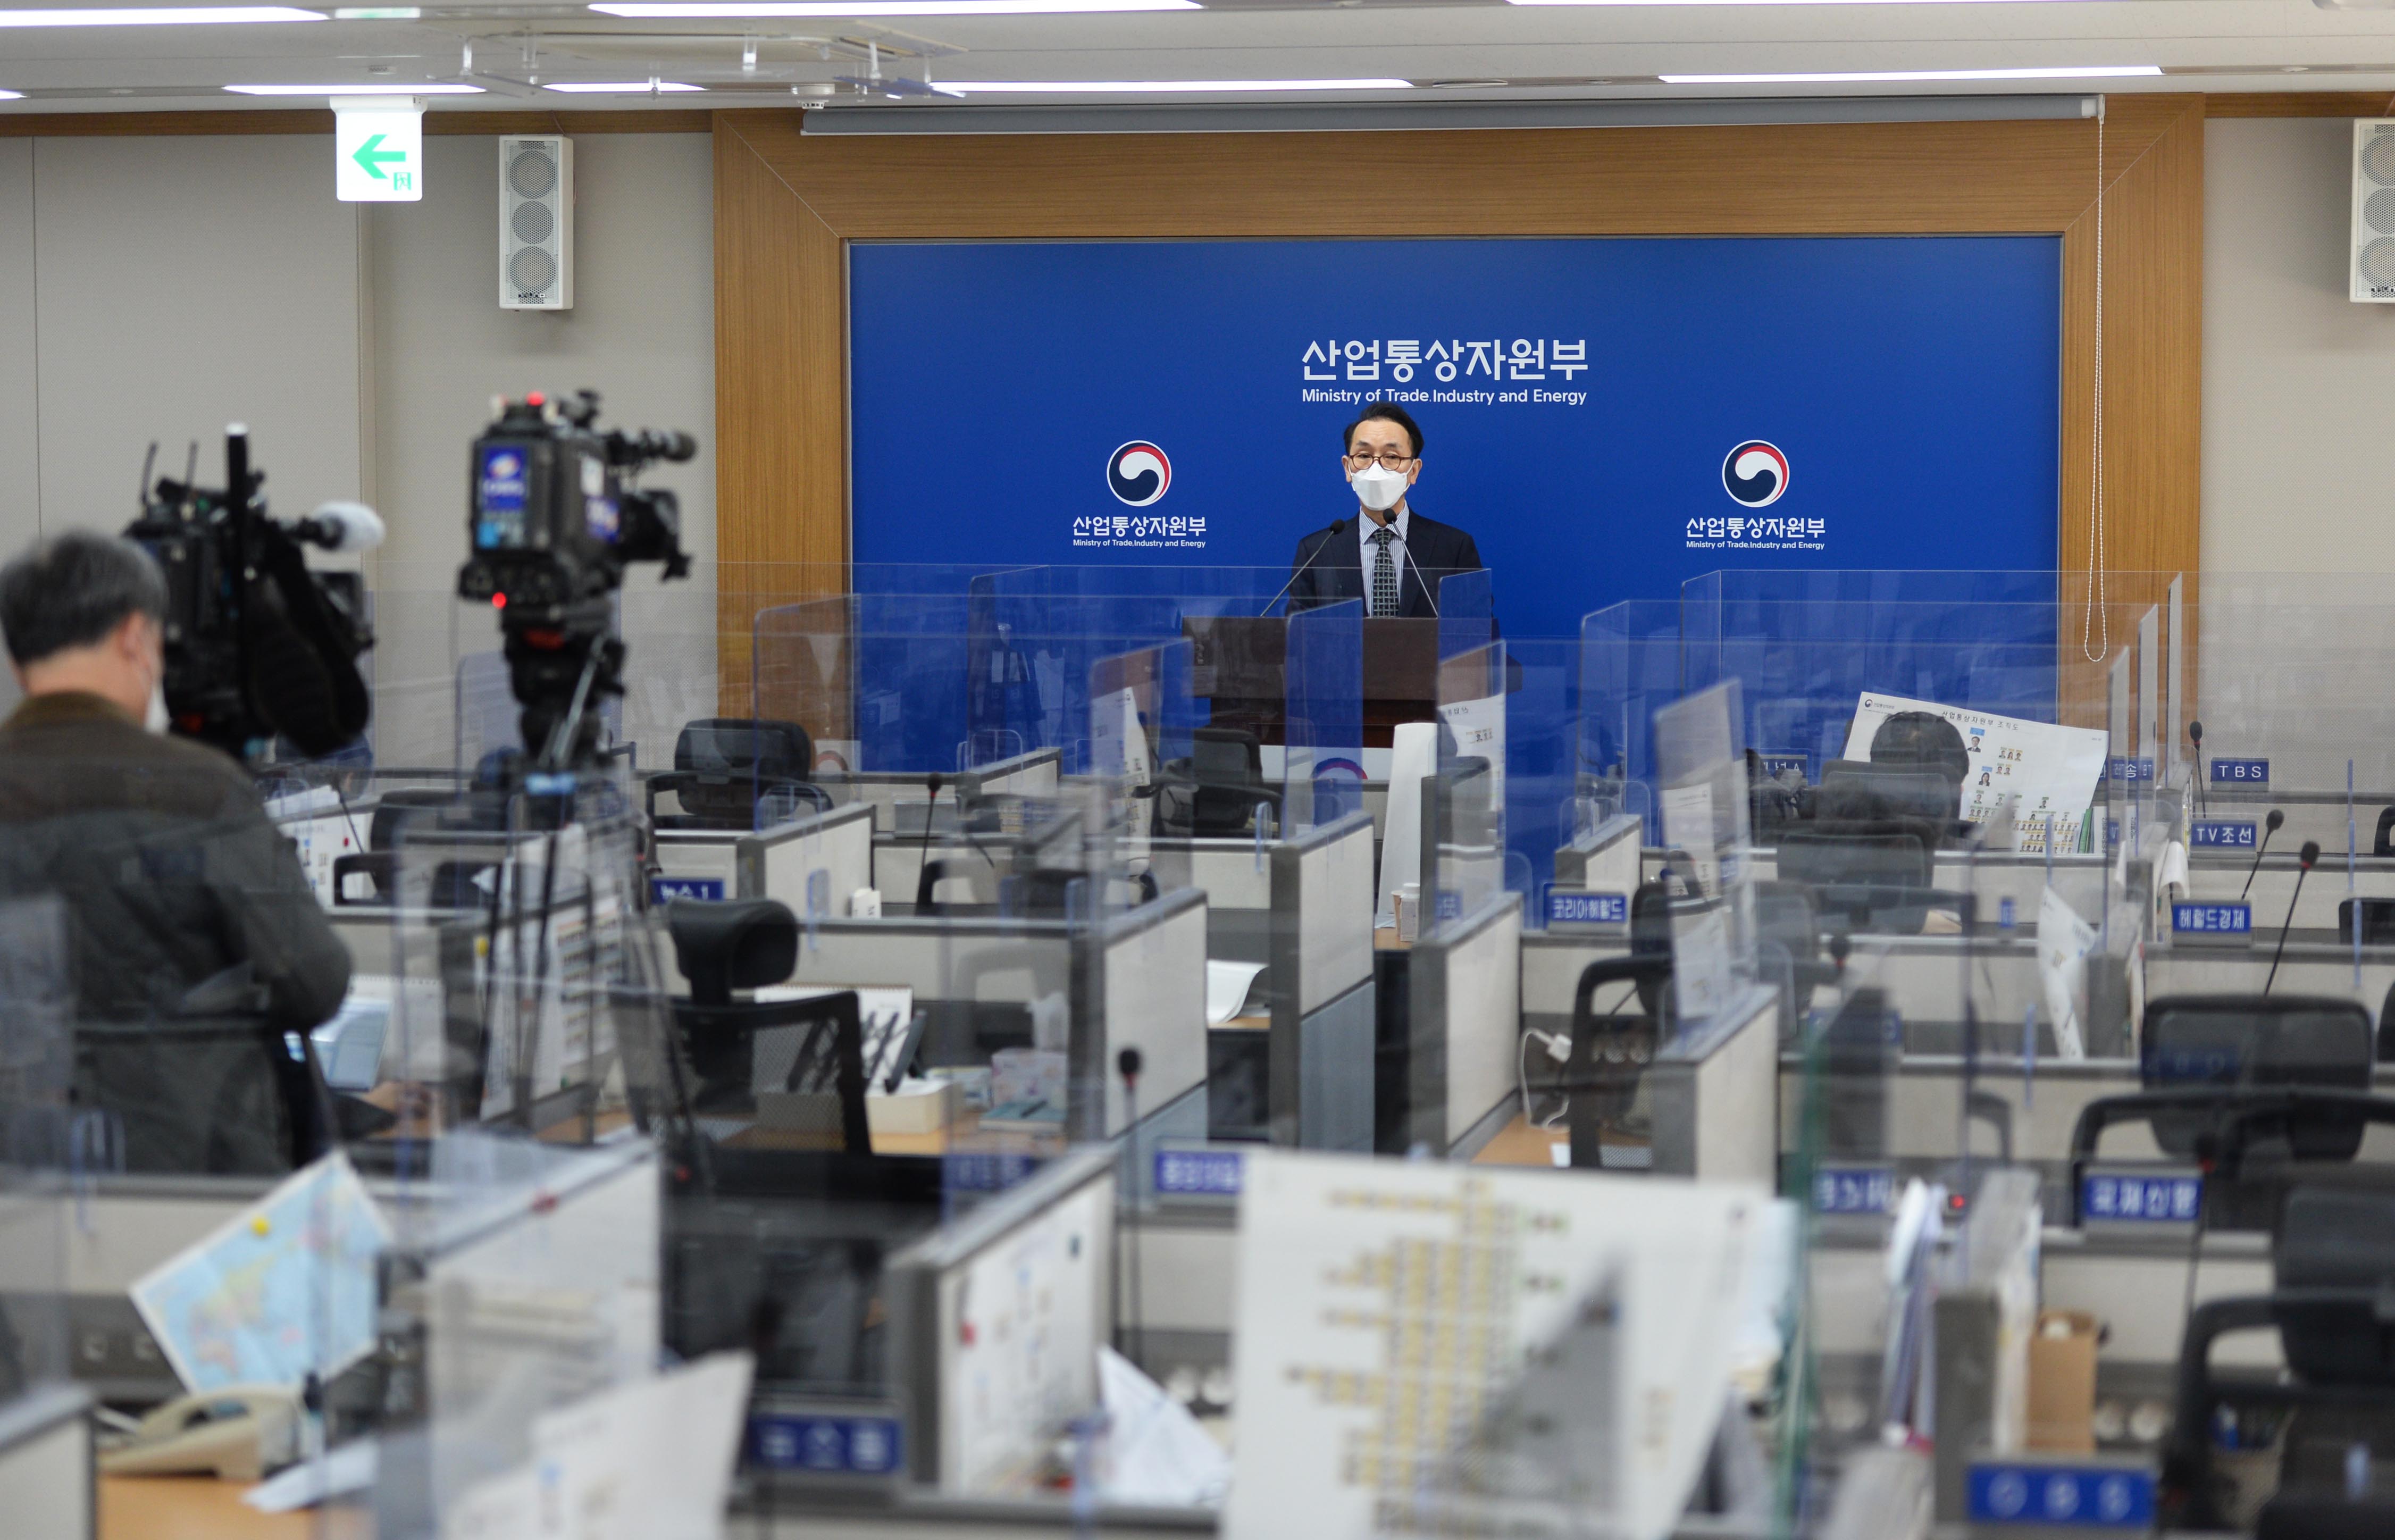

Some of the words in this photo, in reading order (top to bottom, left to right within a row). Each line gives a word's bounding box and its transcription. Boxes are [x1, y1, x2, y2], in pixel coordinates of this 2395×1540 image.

[1302, 339, 1588, 383] 산업통상자원부
[1302, 389, 1361, 405] Ministry
[1365, 389, 1381, 402] of
[1498, 389, 1528, 403] and
[1533, 390, 1587, 406] Energy
[1073, 516, 1207, 537] 산업통상자원부
[1686, 517, 1825, 539] 산업통상자원부
[1180, 540, 1206, 548] Energy
[1798, 541, 1825, 550] Energy
[1942, 711, 1994, 725] 산업통상자원부
[2218, 765, 2262, 778] TBS
[1553, 897, 1622, 920] 코리아헤럴드
[2179, 908, 2246, 930] 헤럴드경제
